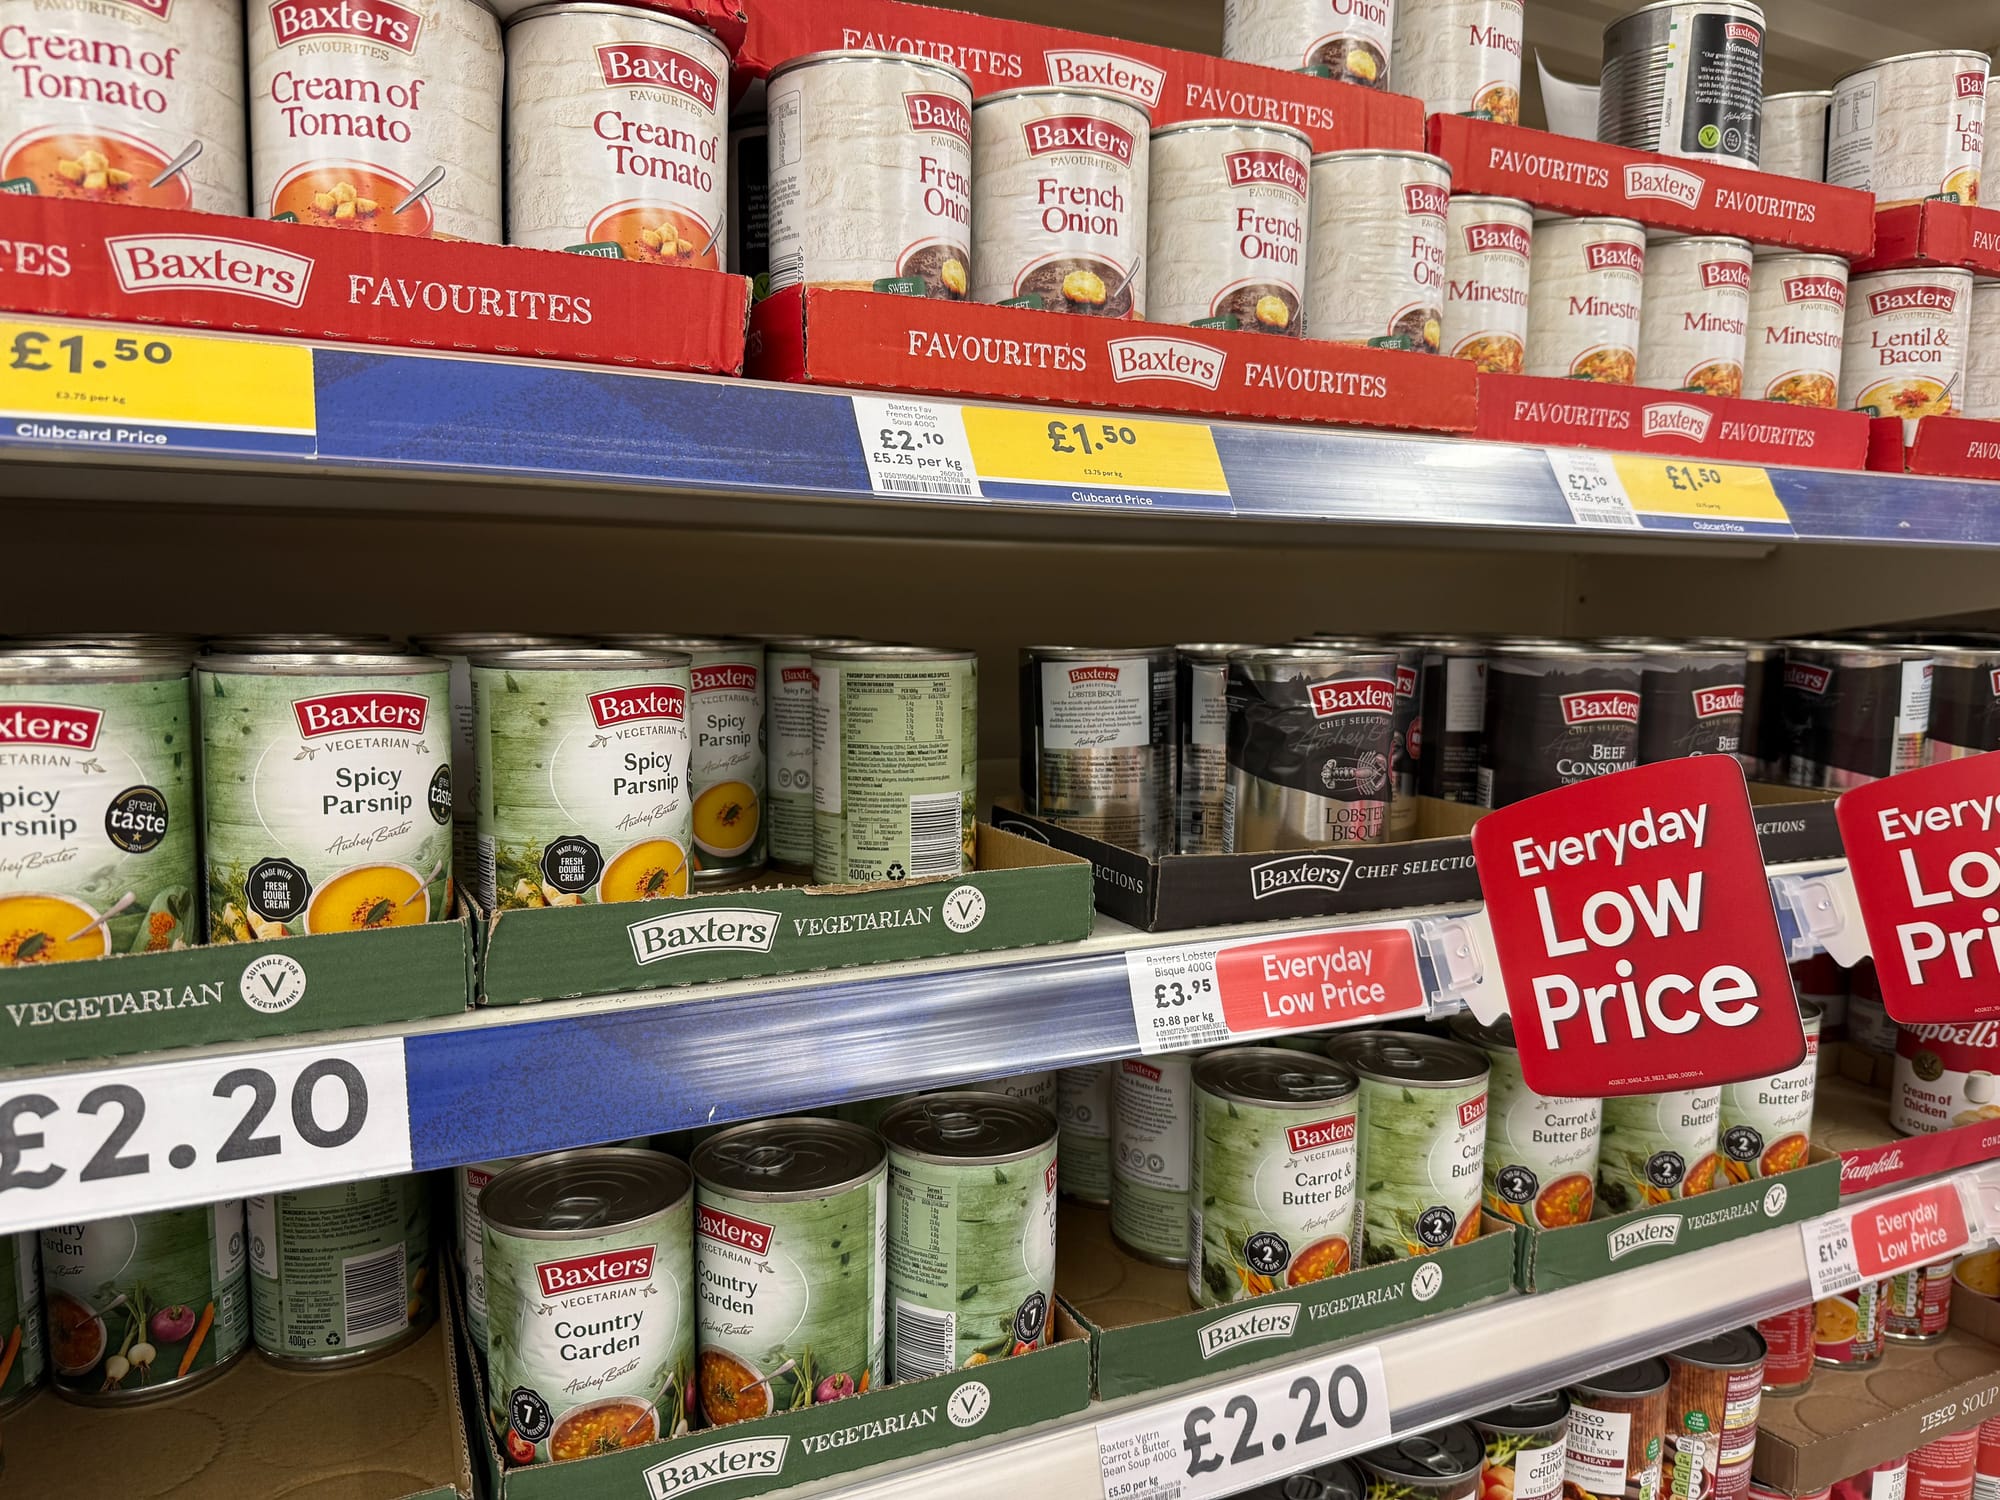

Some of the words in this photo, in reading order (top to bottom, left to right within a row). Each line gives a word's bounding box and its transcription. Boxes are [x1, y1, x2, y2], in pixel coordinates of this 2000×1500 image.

[281, 2, 411, 44] Baxters
[1, 26, 134, 69] Cream
[140, 48, 181, 80] of
[298, 44, 389, 61] FAVOURITES
[13, 65, 168, 114] Tomato
[608, 52, 714, 103] Baxters
[271, 71, 381, 104] Cream
[386, 80, 425, 110] of
[1057, 57, 1155, 97] Baxters
[1186, 84, 1335, 130] FAVOURITES
[629, 90, 702, 118] FAVOURITES
[281, 107, 412, 143] Tomato
[593, 111, 697, 155] Cream
[699, 136, 719, 164] of
[1033, 125, 1129, 158] Baxters
[607, 145, 713, 193] Tomato
[1233, 157, 1307, 193] Baxters
[1037, 179, 1124, 213] French
[1489, 148, 1609, 188] FAVOURITES
[1632, 172, 1696, 202] Baxters
[1715, 189, 1816, 223] FAVOURITES
[1042, 207, 1119, 237] Onion
[1236, 208, 1303, 243] French
[1240, 235, 1299, 266] Onion
[125, 246, 296, 294] Baxters
[348, 274, 593, 327] FAVOURITES
[1876, 287, 1953, 311] Baxters
[1870, 328, 1931, 348] Lentil
[1933, 331, 1950, 346] &
[10, 331, 173, 374] £1.50
[908, 331, 1087, 371] FAVOURITES
[1118, 347, 1214, 381] Baxters
[1244, 363, 1388, 398] FAVOURITES
[1879, 349, 1942, 365] Bacon
[16, 424, 112, 442] Clubcard
[116, 428, 168, 444] Price
[1514, 401, 1631, 430] FAVOURITES
[1649, 410, 1704, 435] Baxters
[1719, 422, 1815, 448] FAVOURITES
[880, 428, 944, 450] £2.10
[1048, 421, 1137, 455] £1.50
[873, 452, 913, 466] £5.25
[917, 456, 944, 469] per
[946, 458, 963, 471] kg
[1568, 474, 1608, 490] £2.10
[1666, 465, 1721, 491] £1.50
[1071, 492, 1123, 505] Clubcard
[1125, 495, 1153, 506] Price
[691, 671, 755, 691] Baxters
[1070, 669, 1117, 682] Baxters
[598, 694, 684, 721] Baxters
[1318, 685, 1393, 711] Baxters
[1570, 698, 1637, 719] Baxters
[304, 698, 421, 731] Baxters
[706, 714, 746, 732] Spicy
[1319, 718, 1347, 730] CHEF
[325, 738, 410, 752] VEGETARIAN
[615, 726, 678, 740] VEGETARIAN
[699, 732, 751, 747] Parsnip
[624, 752, 673, 775] Spicy
[1590, 744, 1626, 759] BEEF
[336, 767, 403, 792] Spicy
[613, 774, 679, 796] Parsnip
[128, 800, 156, 812] great
[323, 791, 413, 816] Parsnip
[1325, 805, 1385, 825] LOBSTER
[111, 809, 166, 834] taste
[1332, 824, 1382, 841] BISQUE
[1512, 802, 1708, 878] Everyday
[558, 865, 586, 874] DOUBLE
[561, 857, 583, 865] FRESH
[265, 881, 288, 890] FRESH
[560, 873, 585, 882] CREAM
[1260, 862, 1341, 891] Baxters
[1355, 864, 1398, 880] CHEF
[263, 890, 291, 900] DOUBLE
[264, 900, 290, 909] CREAM
[1533, 870, 1703, 959] Low
[641, 920, 767, 954] Baxters
[793, 906, 933, 937] VEGETARIAN
[1146, 954, 1182, 965] Baxters
[1182, 950, 1217, 962] Lobster
[1154, 966, 1186, 978] Bisque
[1188, 962, 1213, 973] 400G
[1262, 946, 1373, 982] Everyday
[7, 981, 225, 1027] VEGETARIAN
[1154, 979, 1212, 1009] £3.95
[1263, 989, 1315, 1018] Low
[1320, 980, 1386, 1010] Price
[1531, 958, 1760, 1050] Price
[1153, 1015, 1181, 1028] £9.88
[1182, 1014, 1199, 1026] per
[1200, 1011, 1214, 1023] kg
[1770, 1076, 1808, 1090] Carrot
[1903, 1082, 1937, 1104] Cream
[1938, 1094, 1953, 1106] of
[1759, 1091, 1798, 1105] Butter
[1903, 1097, 1948, 1119] Chicken
[0, 1057, 369, 1192] £2.20
[1544, 1112, 1588, 1127] Carrot
[1294, 1120, 1355, 1148] Baxters
[1532, 1128, 1577, 1144] Butter
[1738, 1137, 1749, 1151] 2
[1295, 1167, 1341, 1188] Carrot
[1662, 1162, 1672, 1176] 2
[1282, 1186, 1331, 1207] Butter
[1512, 1177, 1523, 1192] 2
[697, 1210, 765, 1249] Baxters
[1433, 1219, 1443, 1234] 2
[1614, 1224, 1676, 1253] Baxters
[1687, 1200, 1760, 1231] VEGETARIAN
[1875, 1202, 1939, 1237] Everyday
[1263, 1246, 1273, 1261] 2
[1819, 1238, 1848, 1263] £1.50
[1878, 1236, 1909, 1264] Low
[1911, 1227, 1948, 1254] Price
[544, 1256, 648, 1292] Baxters
[699, 1260, 758, 1297] Country
[561, 1287, 637, 1310] VEGETARIAN
[700, 1283, 754, 1315] Garden
[554, 1310, 645, 1341] Country
[1207, 1313, 1291, 1350] Baxters
[1308, 1282, 1405, 1321] VEGETARIAN
[288, 1335, 307, 1348] 400g
[560, 1334, 640, 1361] Garden
[523, 1404, 533, 1423] 7
[1568, 1409, 1605, 1425] TESCO
[1922, 1404, 1956, 1426] TESCO
[1961, 1386, 1999, 1415] SOUP
[1183, 1364, 1368, 1478] £2.20
[655, 1445, 776, 1496] Baxters
[800, 1406, 938, 1455] VEGETARIAN
[1099, 1437, 1134, 1455] Baxters
[1101, 1449, 1131, 1466] Carrot
[1133, 1447, 1141, 1456] &
[1142, 1438, 1171, 1455] Butter
[1598, 1447, 1618, 1457] SOUP
[1102, 1463, 1127, 1479] Bean
[1128, 1458, 1151, 1475] Soup
[1152, 1448, 1177, 1463] 400G
[1581, 1455, 1612, 1467] MEATY
[1108, 1482, 1132, 1498] £5.50
[1133, 1479, 1149, 1494] per
[1149, 1476, 1159, 1489] kg
